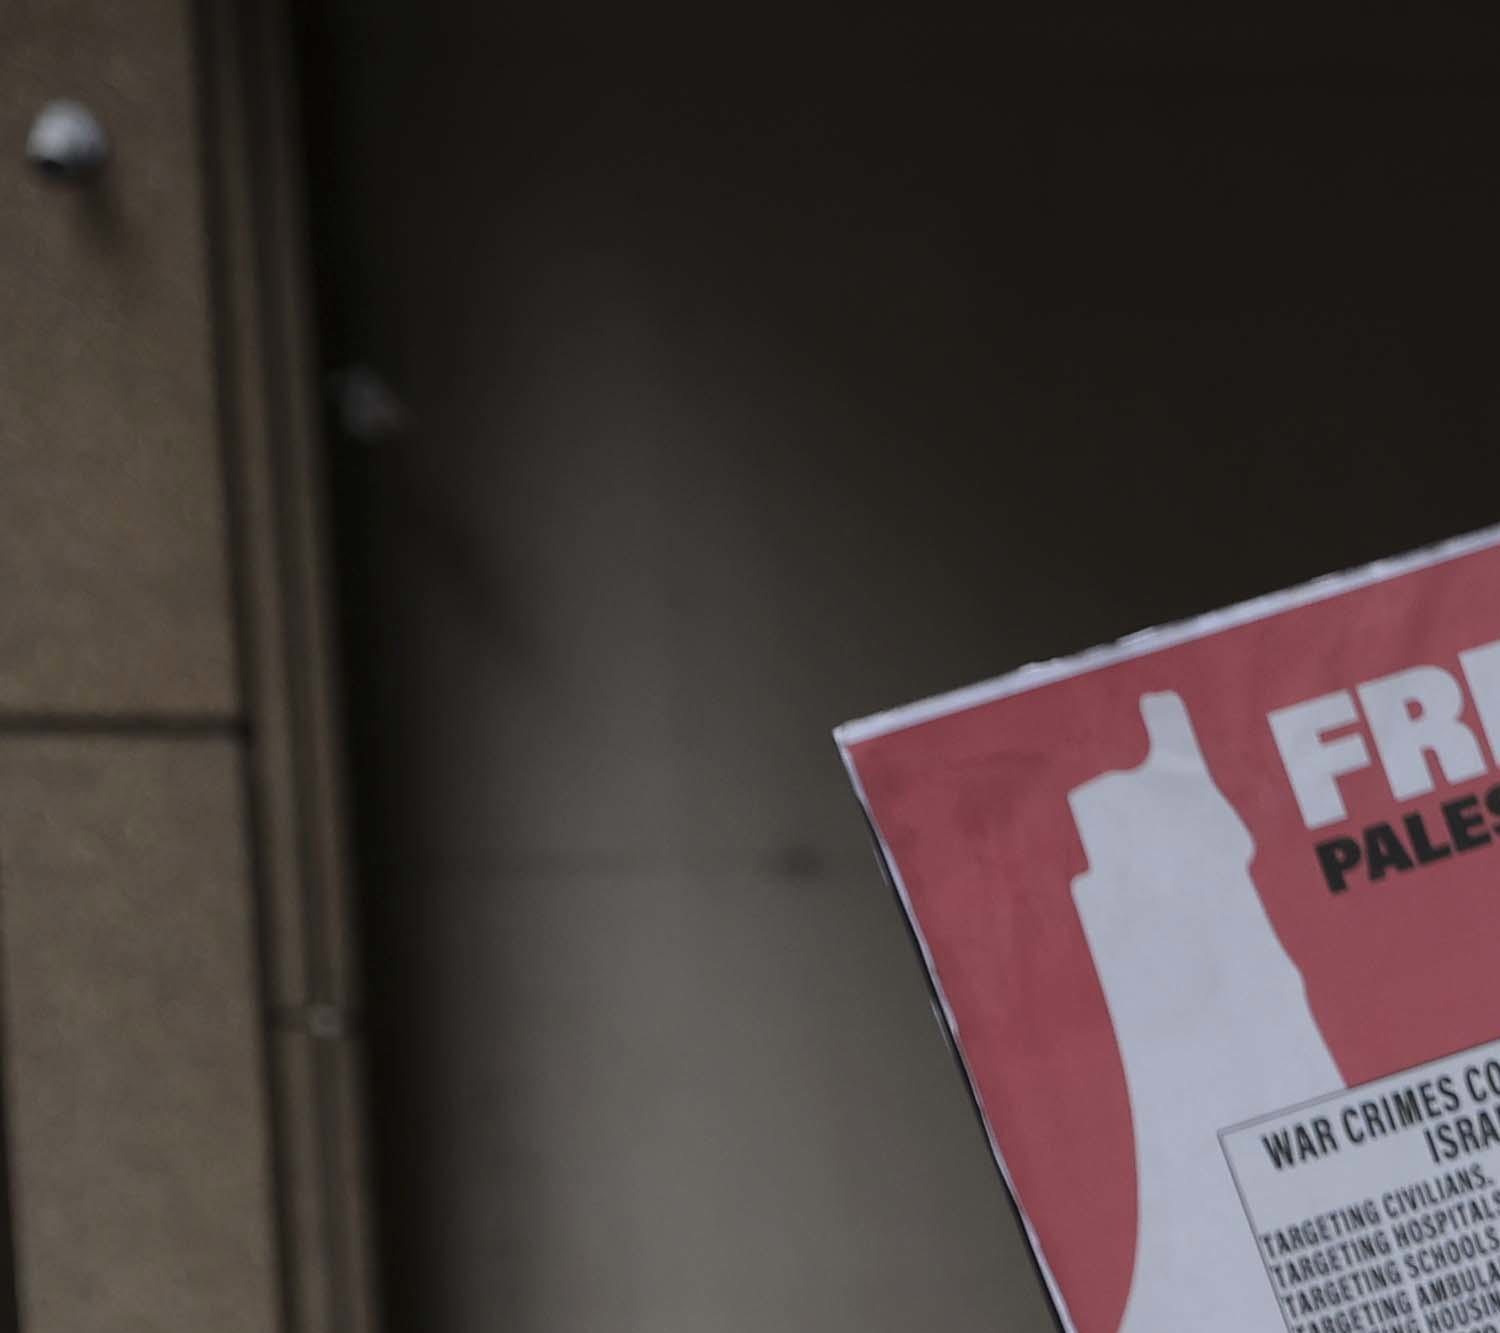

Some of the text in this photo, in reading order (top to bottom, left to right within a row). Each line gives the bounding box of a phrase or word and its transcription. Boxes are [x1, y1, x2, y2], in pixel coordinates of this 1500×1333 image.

[1261, 1116, 1339, 1171] WAR
[1340, 1075, 1461, 1145] CRIMES
[1259, 1163, 1494, 1259] TARGETING CIVILIANS.
[1270, 1230, 1392, 1289] TARGETING
[1282, 1260, 1403, 1319] TARGETING
